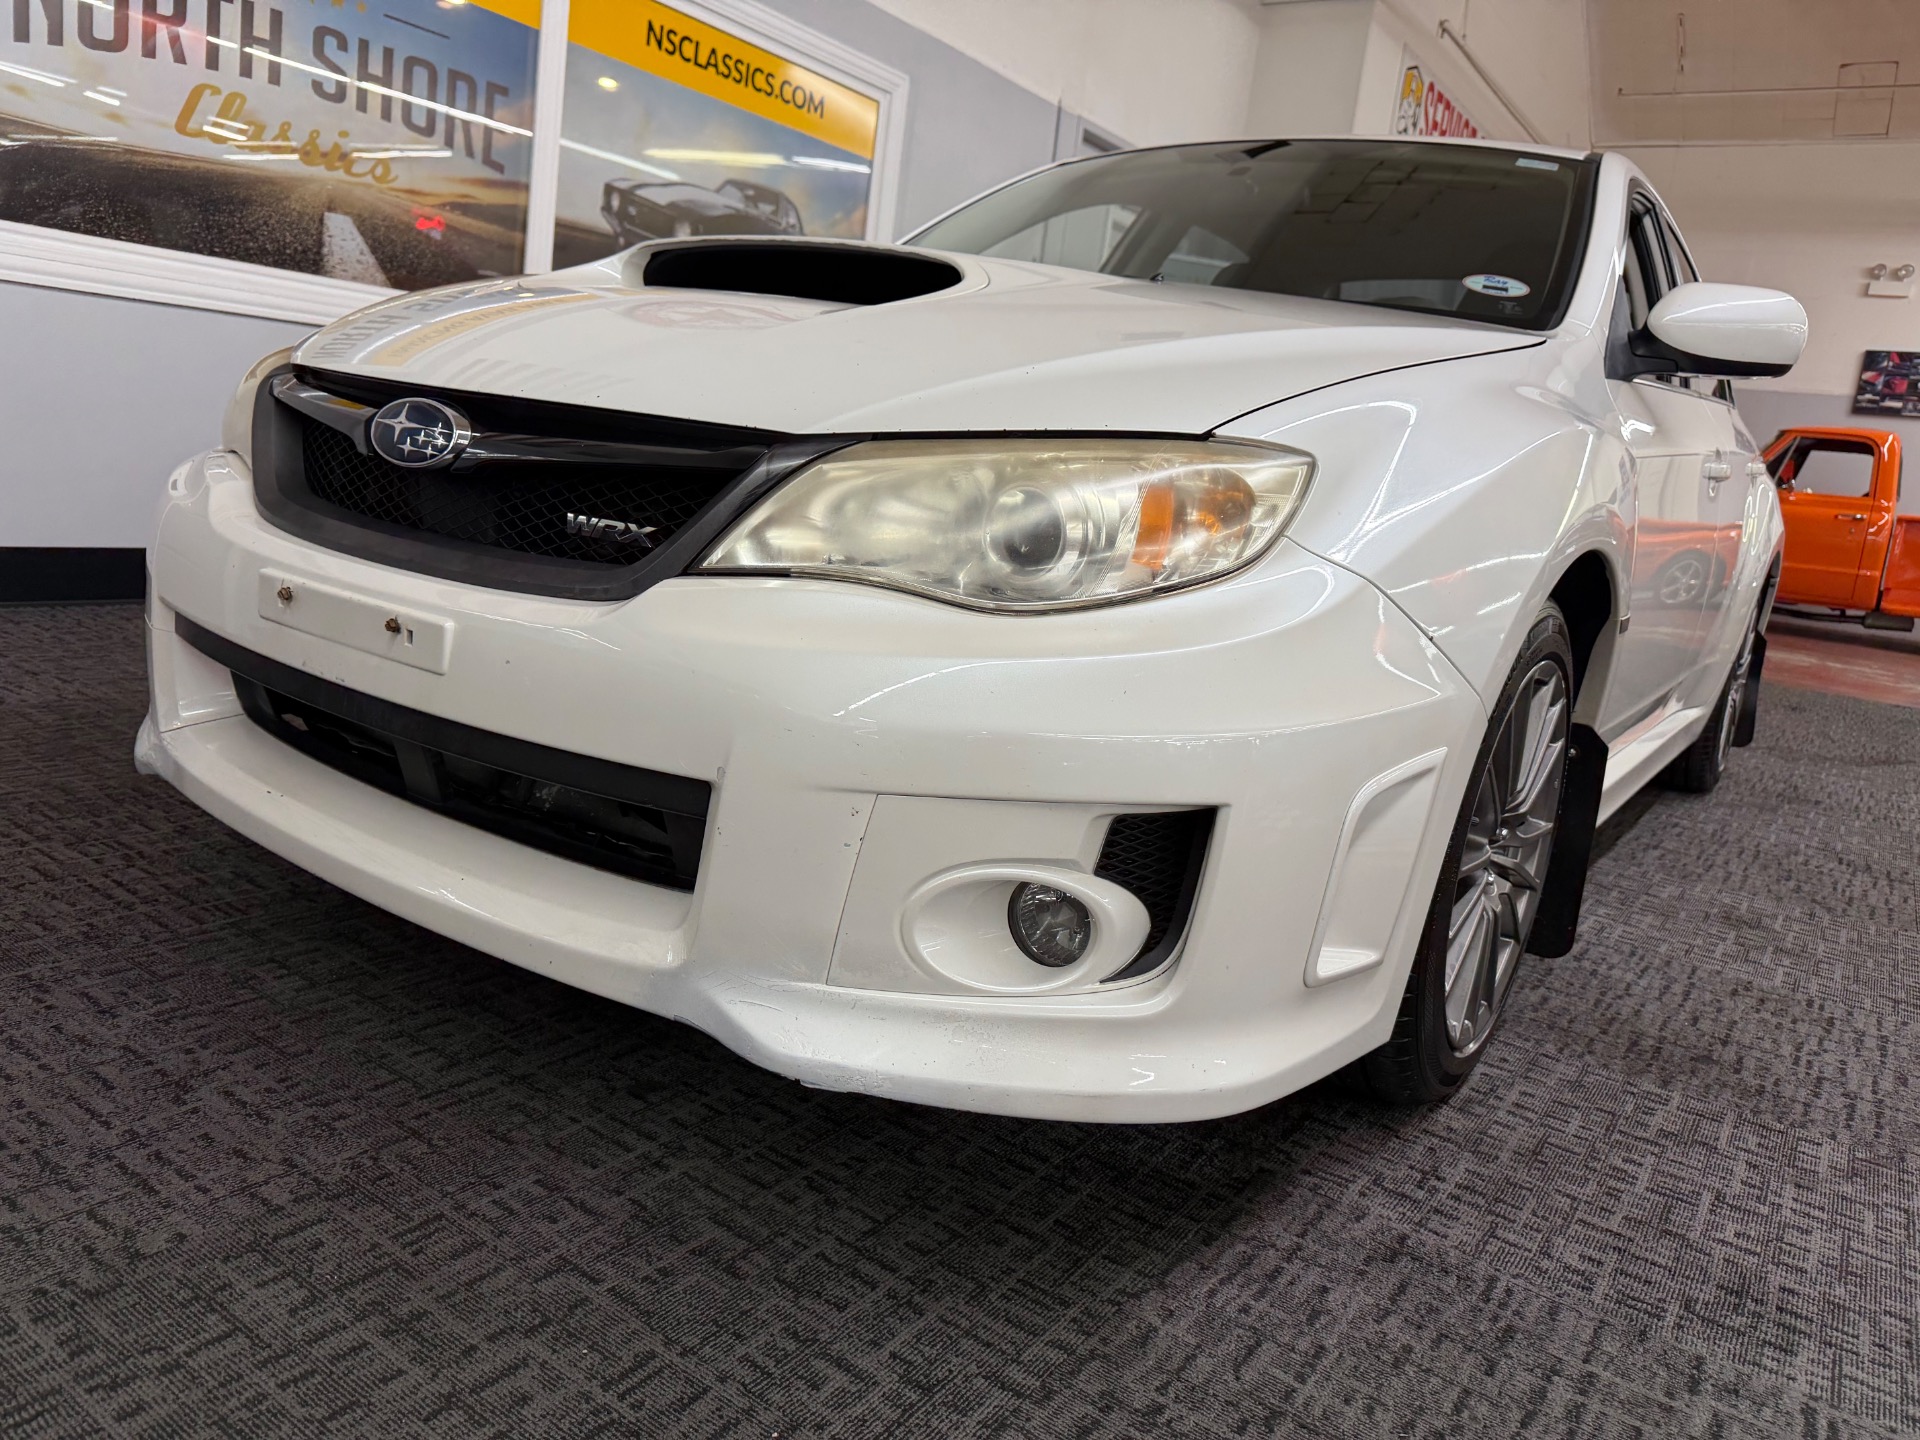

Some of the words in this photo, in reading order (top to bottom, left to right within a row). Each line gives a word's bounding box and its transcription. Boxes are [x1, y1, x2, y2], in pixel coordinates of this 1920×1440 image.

[13, 0, 282, 88] NORTH
[311, 25, 509, 175] SHORE
[646, 19, 826, 119] NSCLASSICS.COM
[1418, 80, 1478, 138] SERV
[174, 83, 399, 184] Classics
[566, 512, 658, 548] WRX
